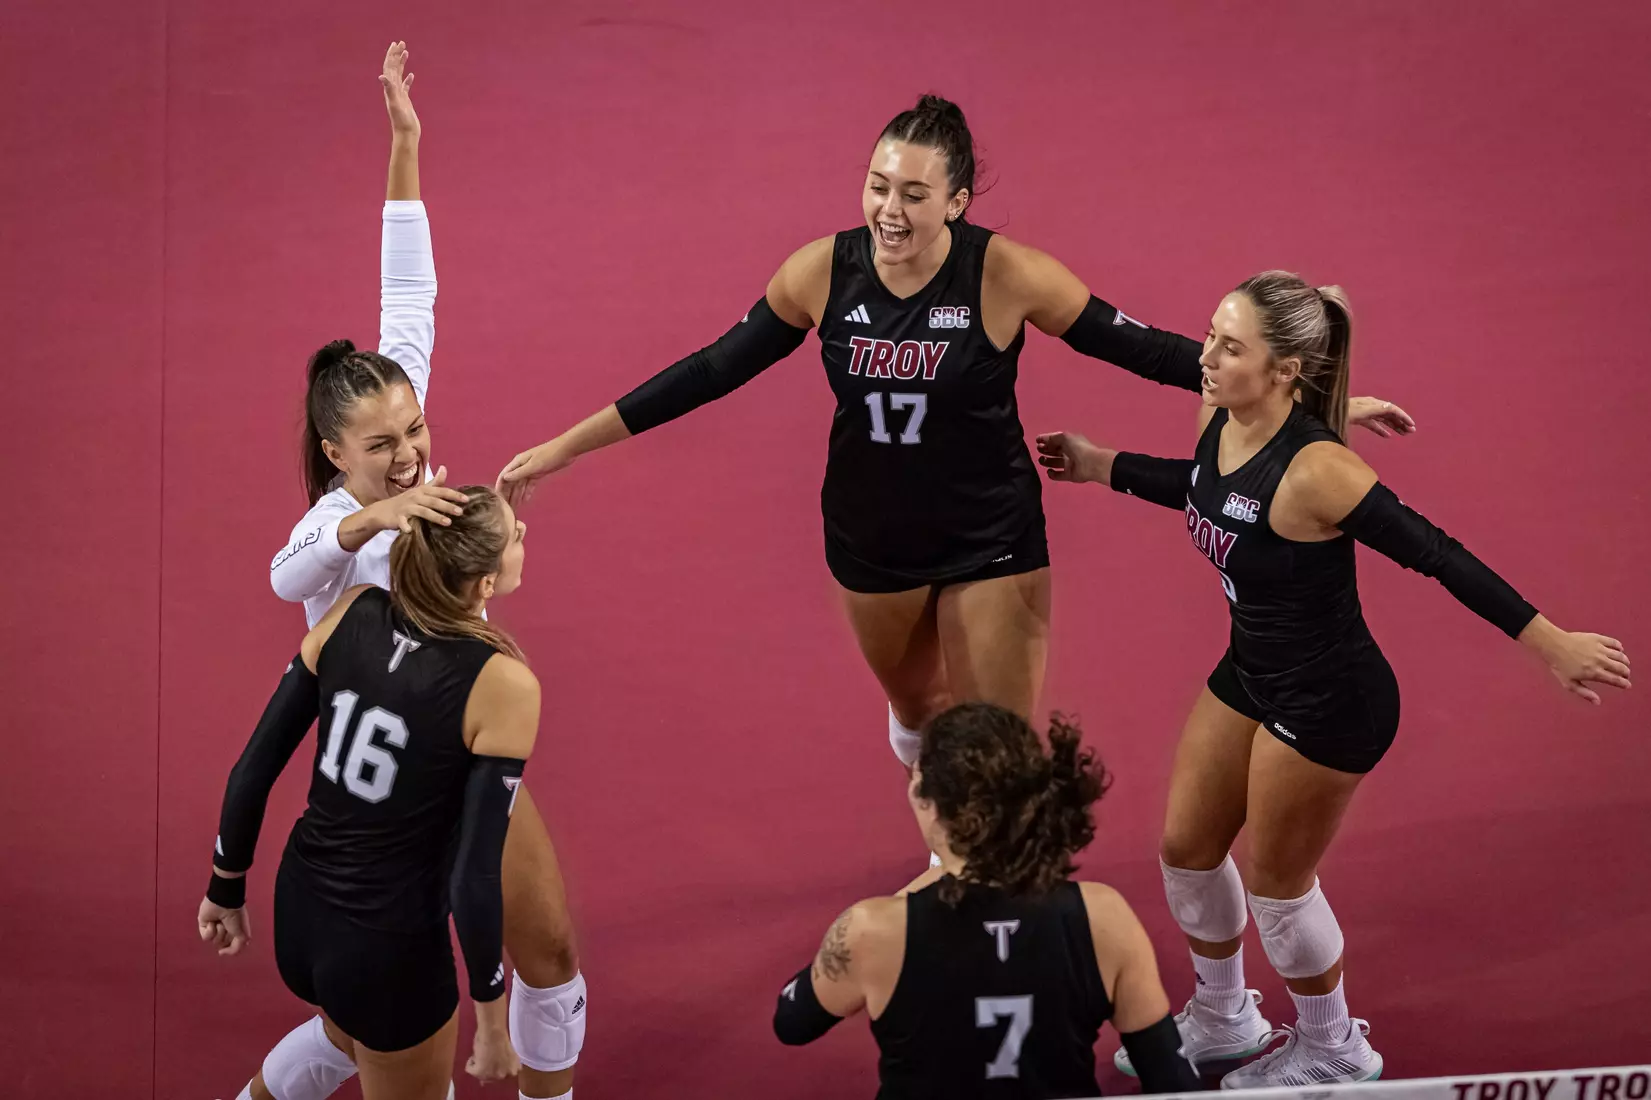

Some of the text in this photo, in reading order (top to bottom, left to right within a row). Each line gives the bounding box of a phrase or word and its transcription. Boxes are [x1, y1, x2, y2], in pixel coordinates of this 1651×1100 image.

[929, 307, 970, 328] SBC
[848, 336, 950, 380] TROY
[864, 392, 928, 444] 17
[1186, 494, 1238, 568] ROY
[1222, 492, 1260, 523] SBC
[319, 690, 410, 804] 16
[975, 994, 1034, 1079] 7
[1453, 1077, 1556, 1100] TROY
